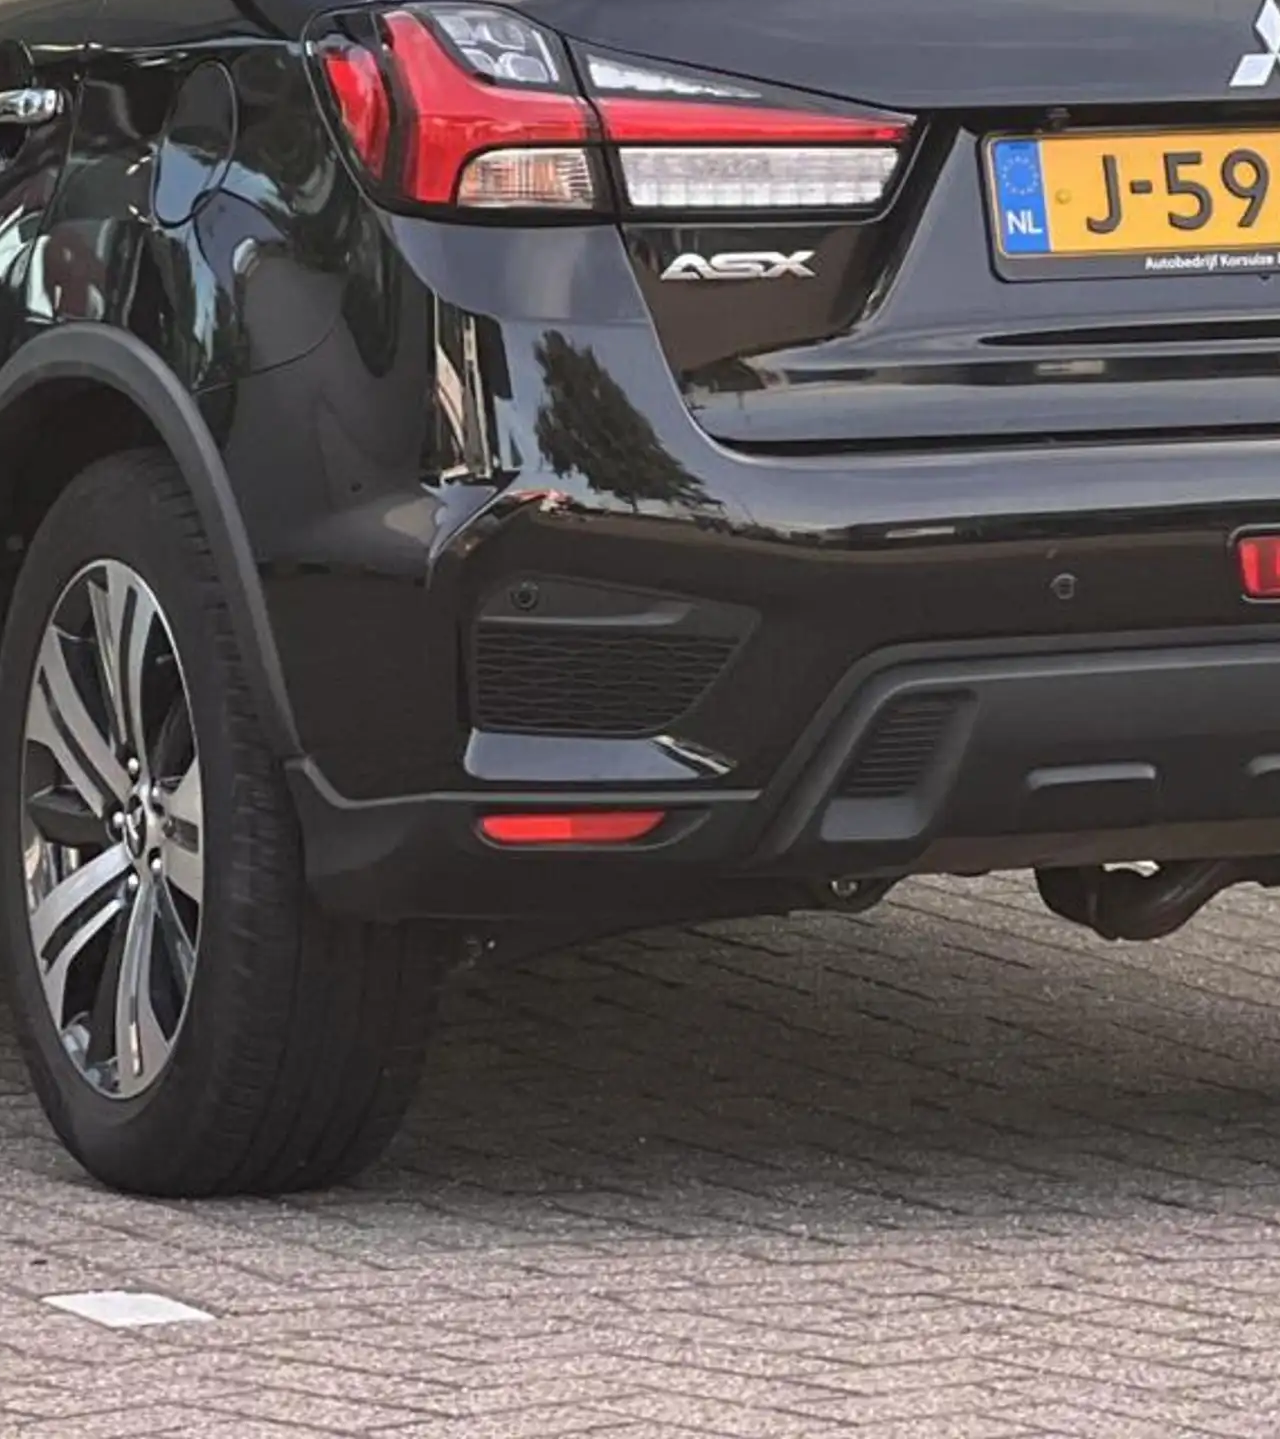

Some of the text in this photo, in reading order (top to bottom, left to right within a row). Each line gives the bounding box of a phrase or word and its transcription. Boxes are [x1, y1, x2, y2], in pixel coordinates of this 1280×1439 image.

[1006, 210, 1043, 235] NL
[660, 250, 817, 281] ASX
[1145, 252, 1219, 270] Autobedrijf
